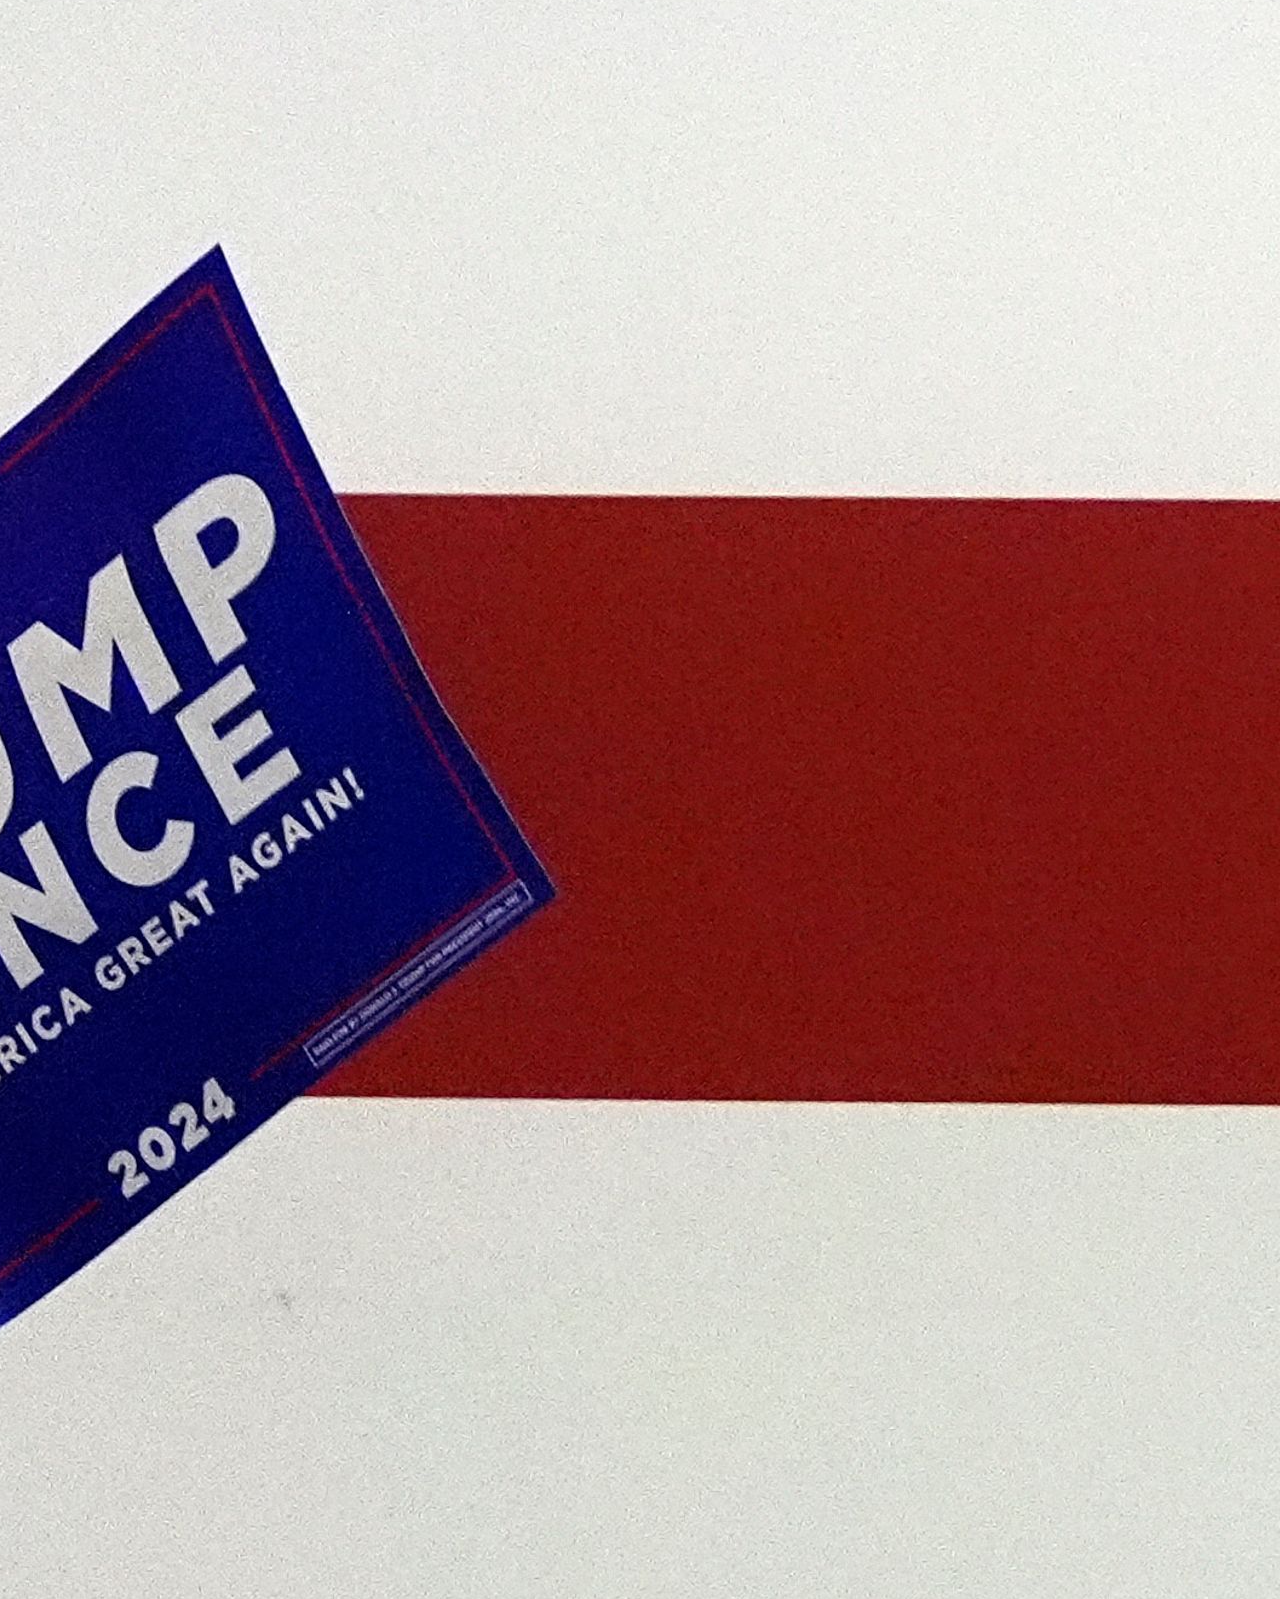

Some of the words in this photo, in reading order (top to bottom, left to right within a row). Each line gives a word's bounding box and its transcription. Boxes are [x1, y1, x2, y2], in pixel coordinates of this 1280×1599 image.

[94, 879, 216, 991] GREAT
[228, 766, 365, 894] AGAIN!
[107, 1077, 236, 1199] 2024
